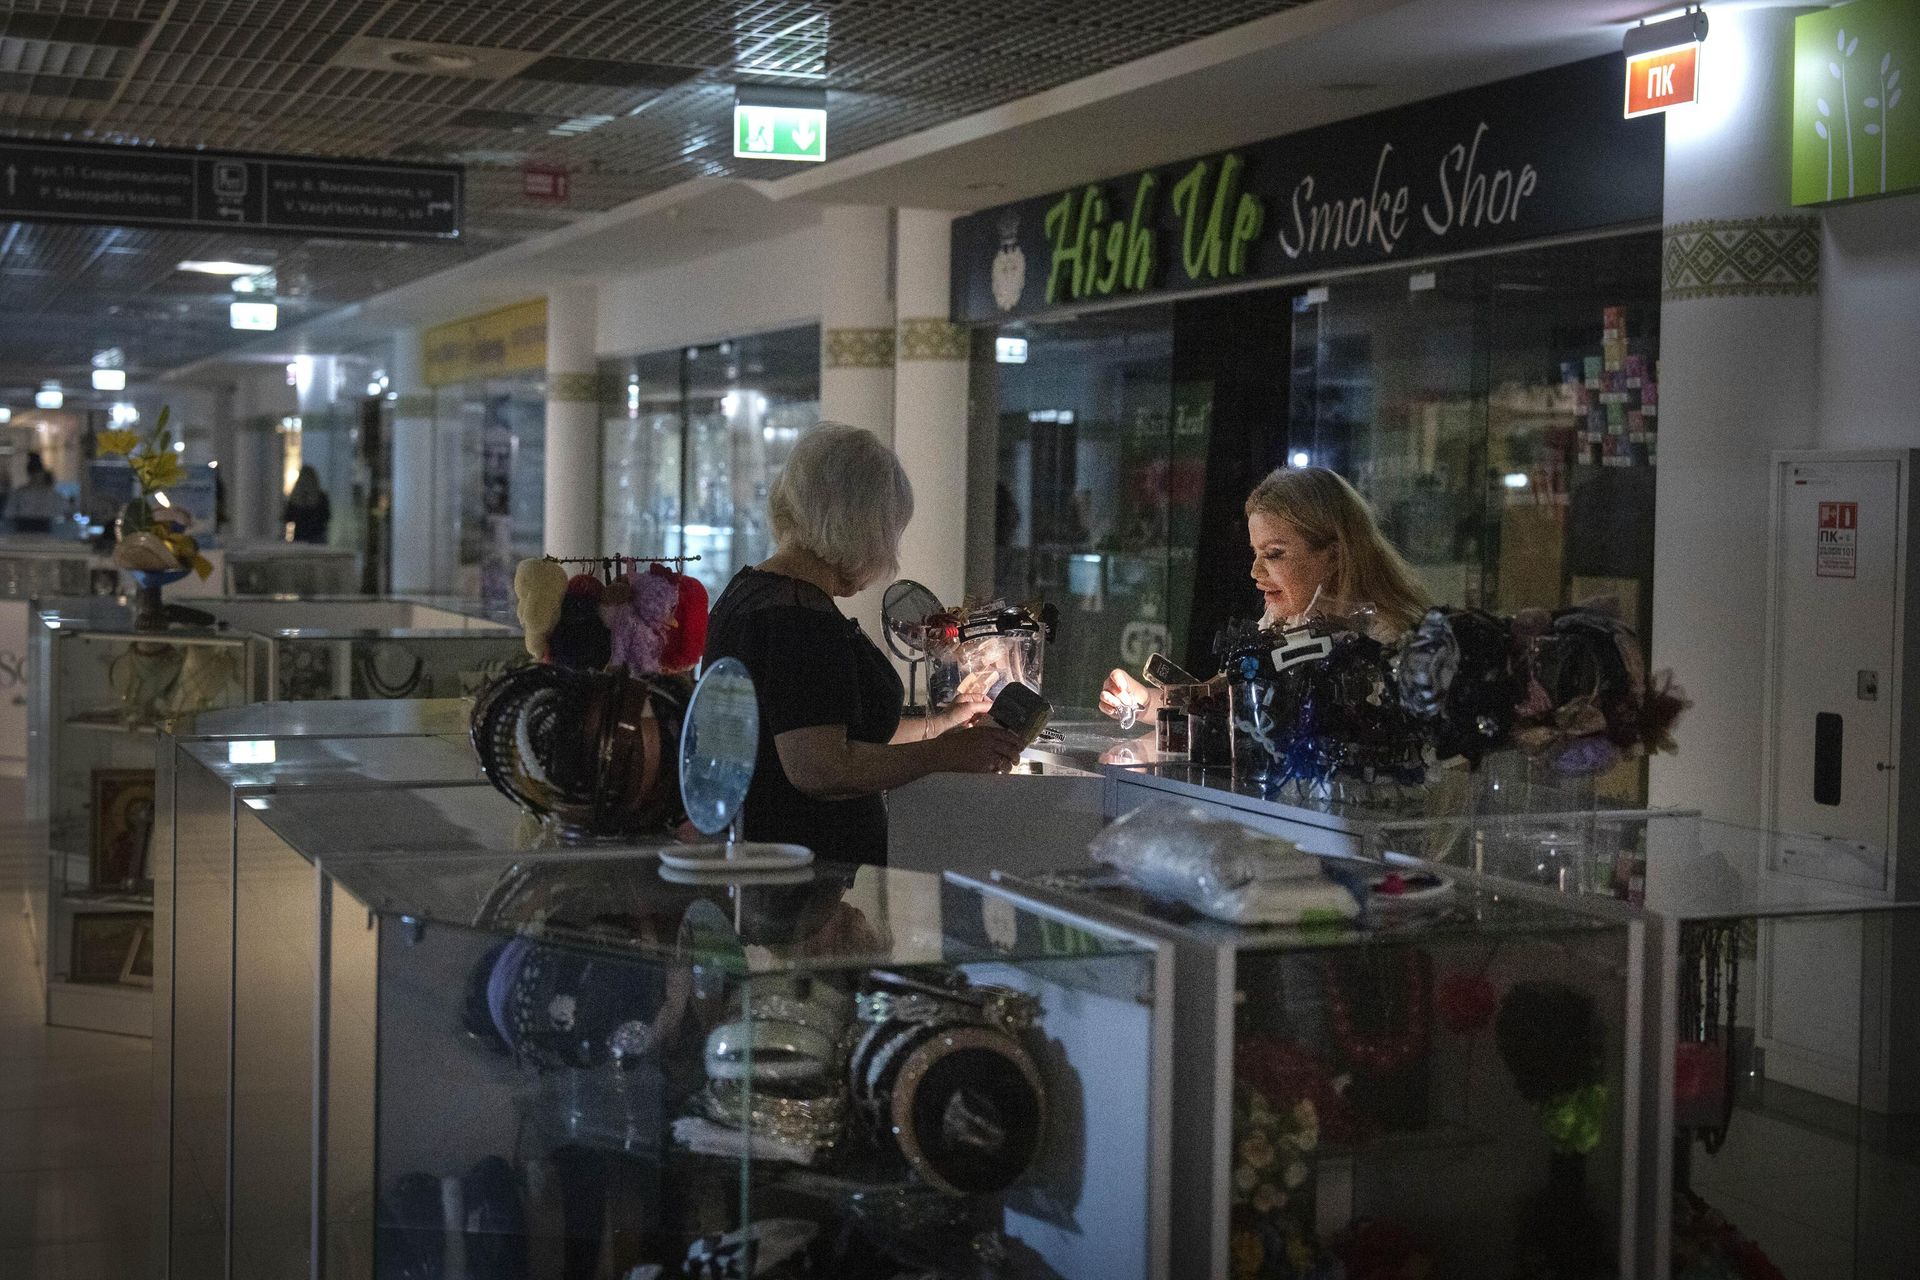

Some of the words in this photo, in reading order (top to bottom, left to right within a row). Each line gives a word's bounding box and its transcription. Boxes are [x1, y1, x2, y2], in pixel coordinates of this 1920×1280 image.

[1647, 63, 1676, 99] ПК
[1044, 173, 1158, 304] High
[1172, 153, 1264, 279] Up
[1279, 142, 1410, 259] Smoke
[1422, 122, 1537, 236] Shop
